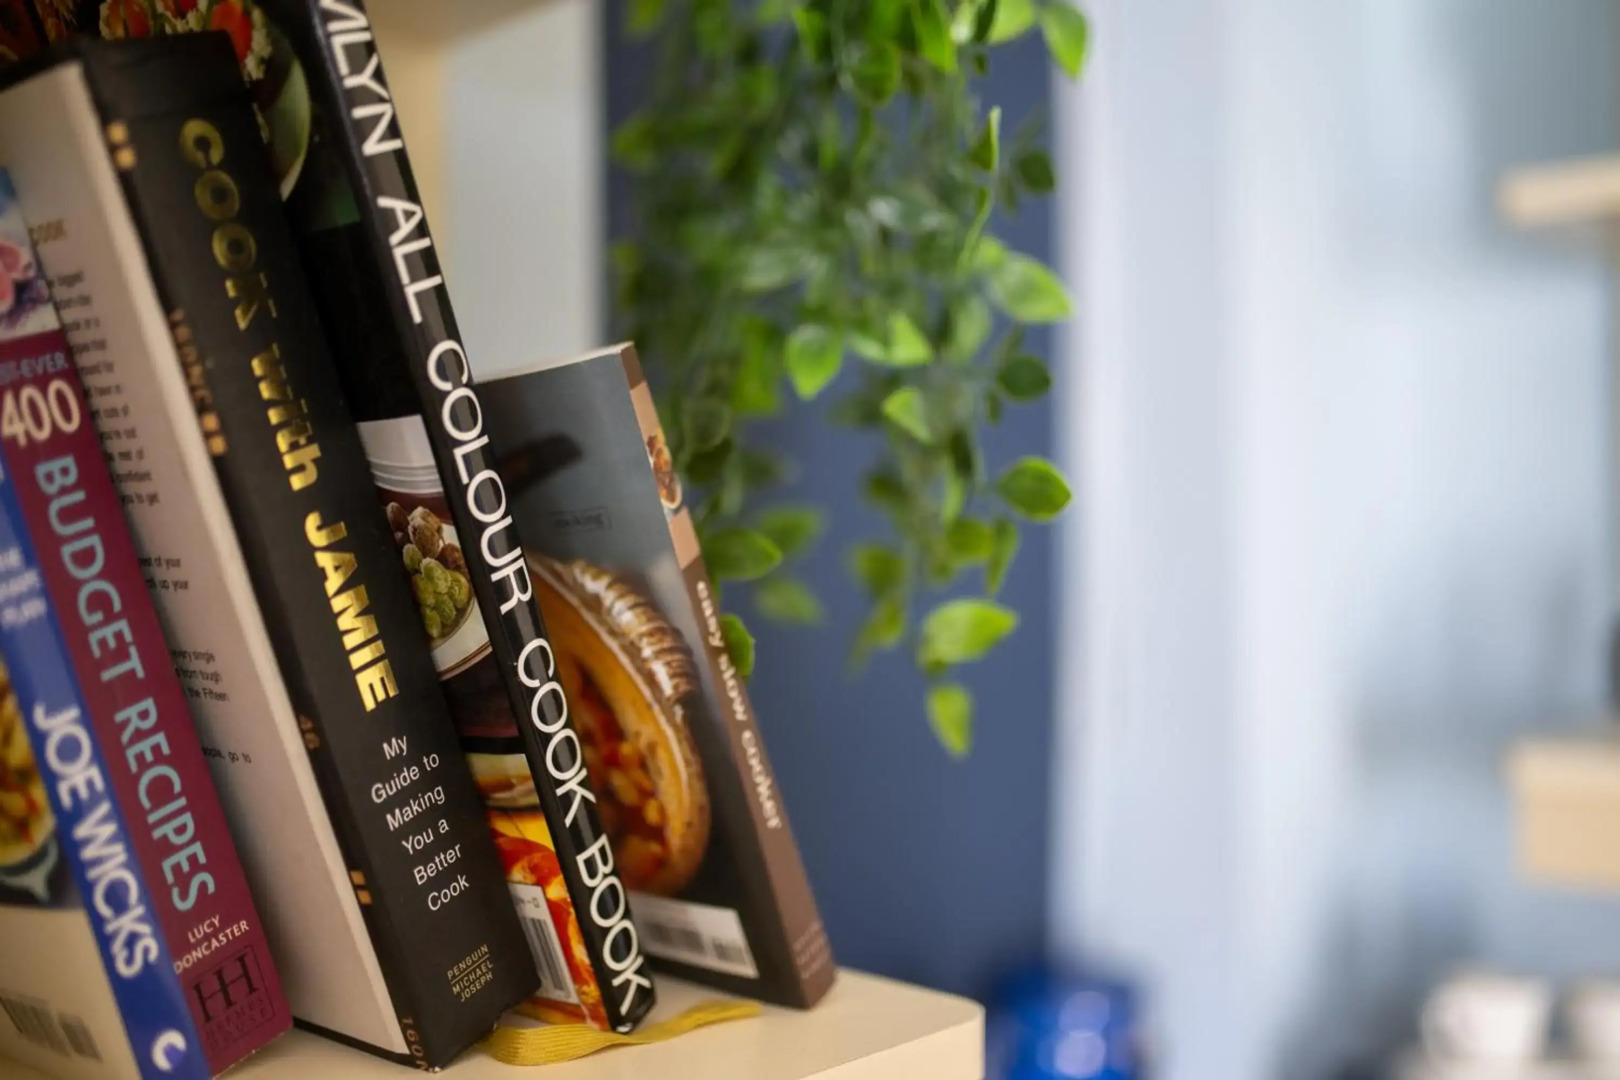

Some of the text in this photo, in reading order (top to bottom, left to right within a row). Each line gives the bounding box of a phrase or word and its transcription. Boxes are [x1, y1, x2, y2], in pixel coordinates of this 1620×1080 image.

[1, 379, 81, 447] 400
[180, 118, 277, 332] COOK
[251, 343, 322, 493] with
[305, 511, 399, 713] JAMIE
[377, 195, 442, 324] ALL
[427, 339, 533, 615] COLOUR
[517, 637, 596, 828] COOK
[576, 833, 651, 1016] BOOK
[35, 453, 216, 911] BUDGET RECIPES
[697, 580, 782, 829] easy slow cooker
[382, 735, 407, 760] My
[371, 753, 440, 804] Guide to
[386, 785, 445, 831] Making
[33, 700, 159, 978] JOE WICKS
[402, 818, 450, 855] You a
[413, 843, 461, 885] Better
[427, 874, 470, 911] Cook
[173, 920, 250, 975] DONCASTER
[187, 914, 220, 943] LUCY
[447, 944, 488, 980] PENGUIN
[452, 960, 494, 995] MICHAEL
[461, 971, 493, 1002] JOSEPH
